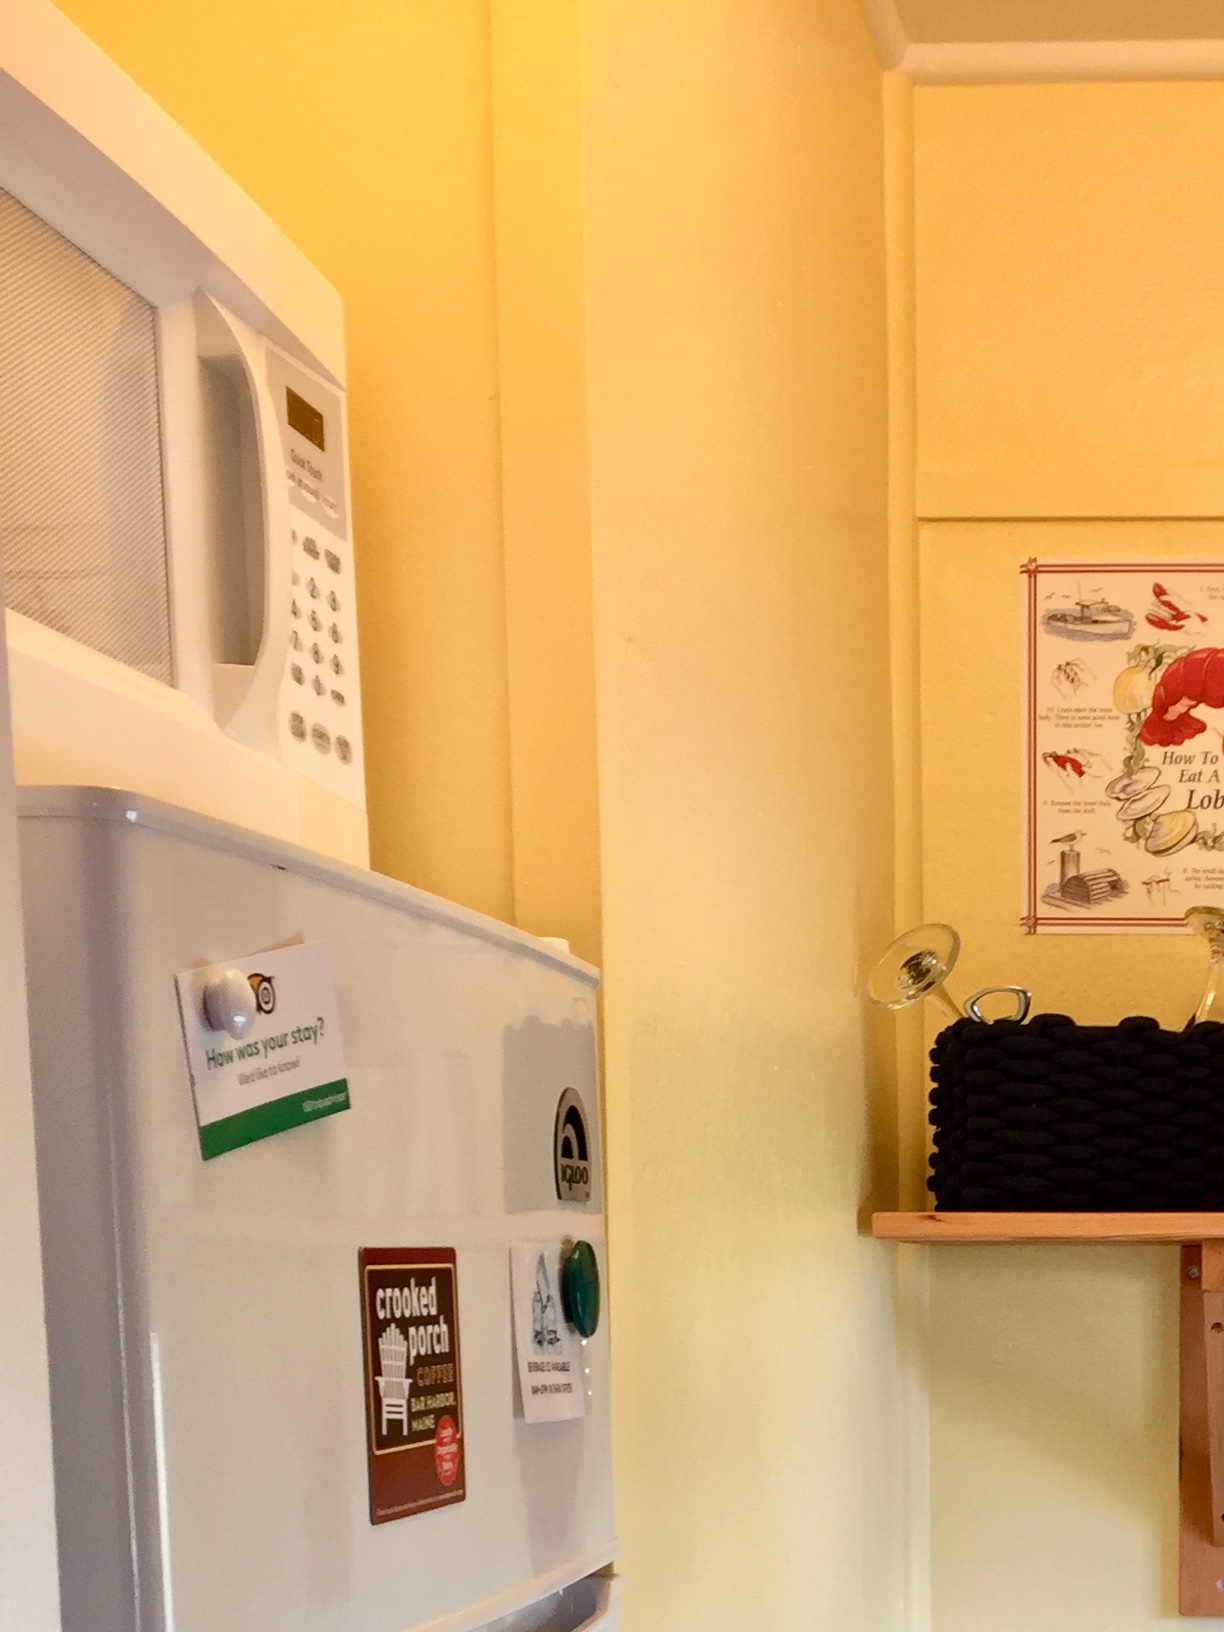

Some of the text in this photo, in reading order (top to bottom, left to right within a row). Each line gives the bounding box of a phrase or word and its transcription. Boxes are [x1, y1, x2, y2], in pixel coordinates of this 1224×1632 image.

[1161, 750, 1219, 766] How To
[1178, 769, 1221, 784] Eat A
[206, 1016, 325, 1070] How was your stay?
[560, 1164, 589, 1191] IGLOO
[375, 1275, 438, 1320] crooked
[408, 1314, 450, 1366] porch
[416, 1362, 454, 1387] COFFEE
[410, 1396, 425, 1413] BAR
[411, 1413, 436, 1432] MAINE
